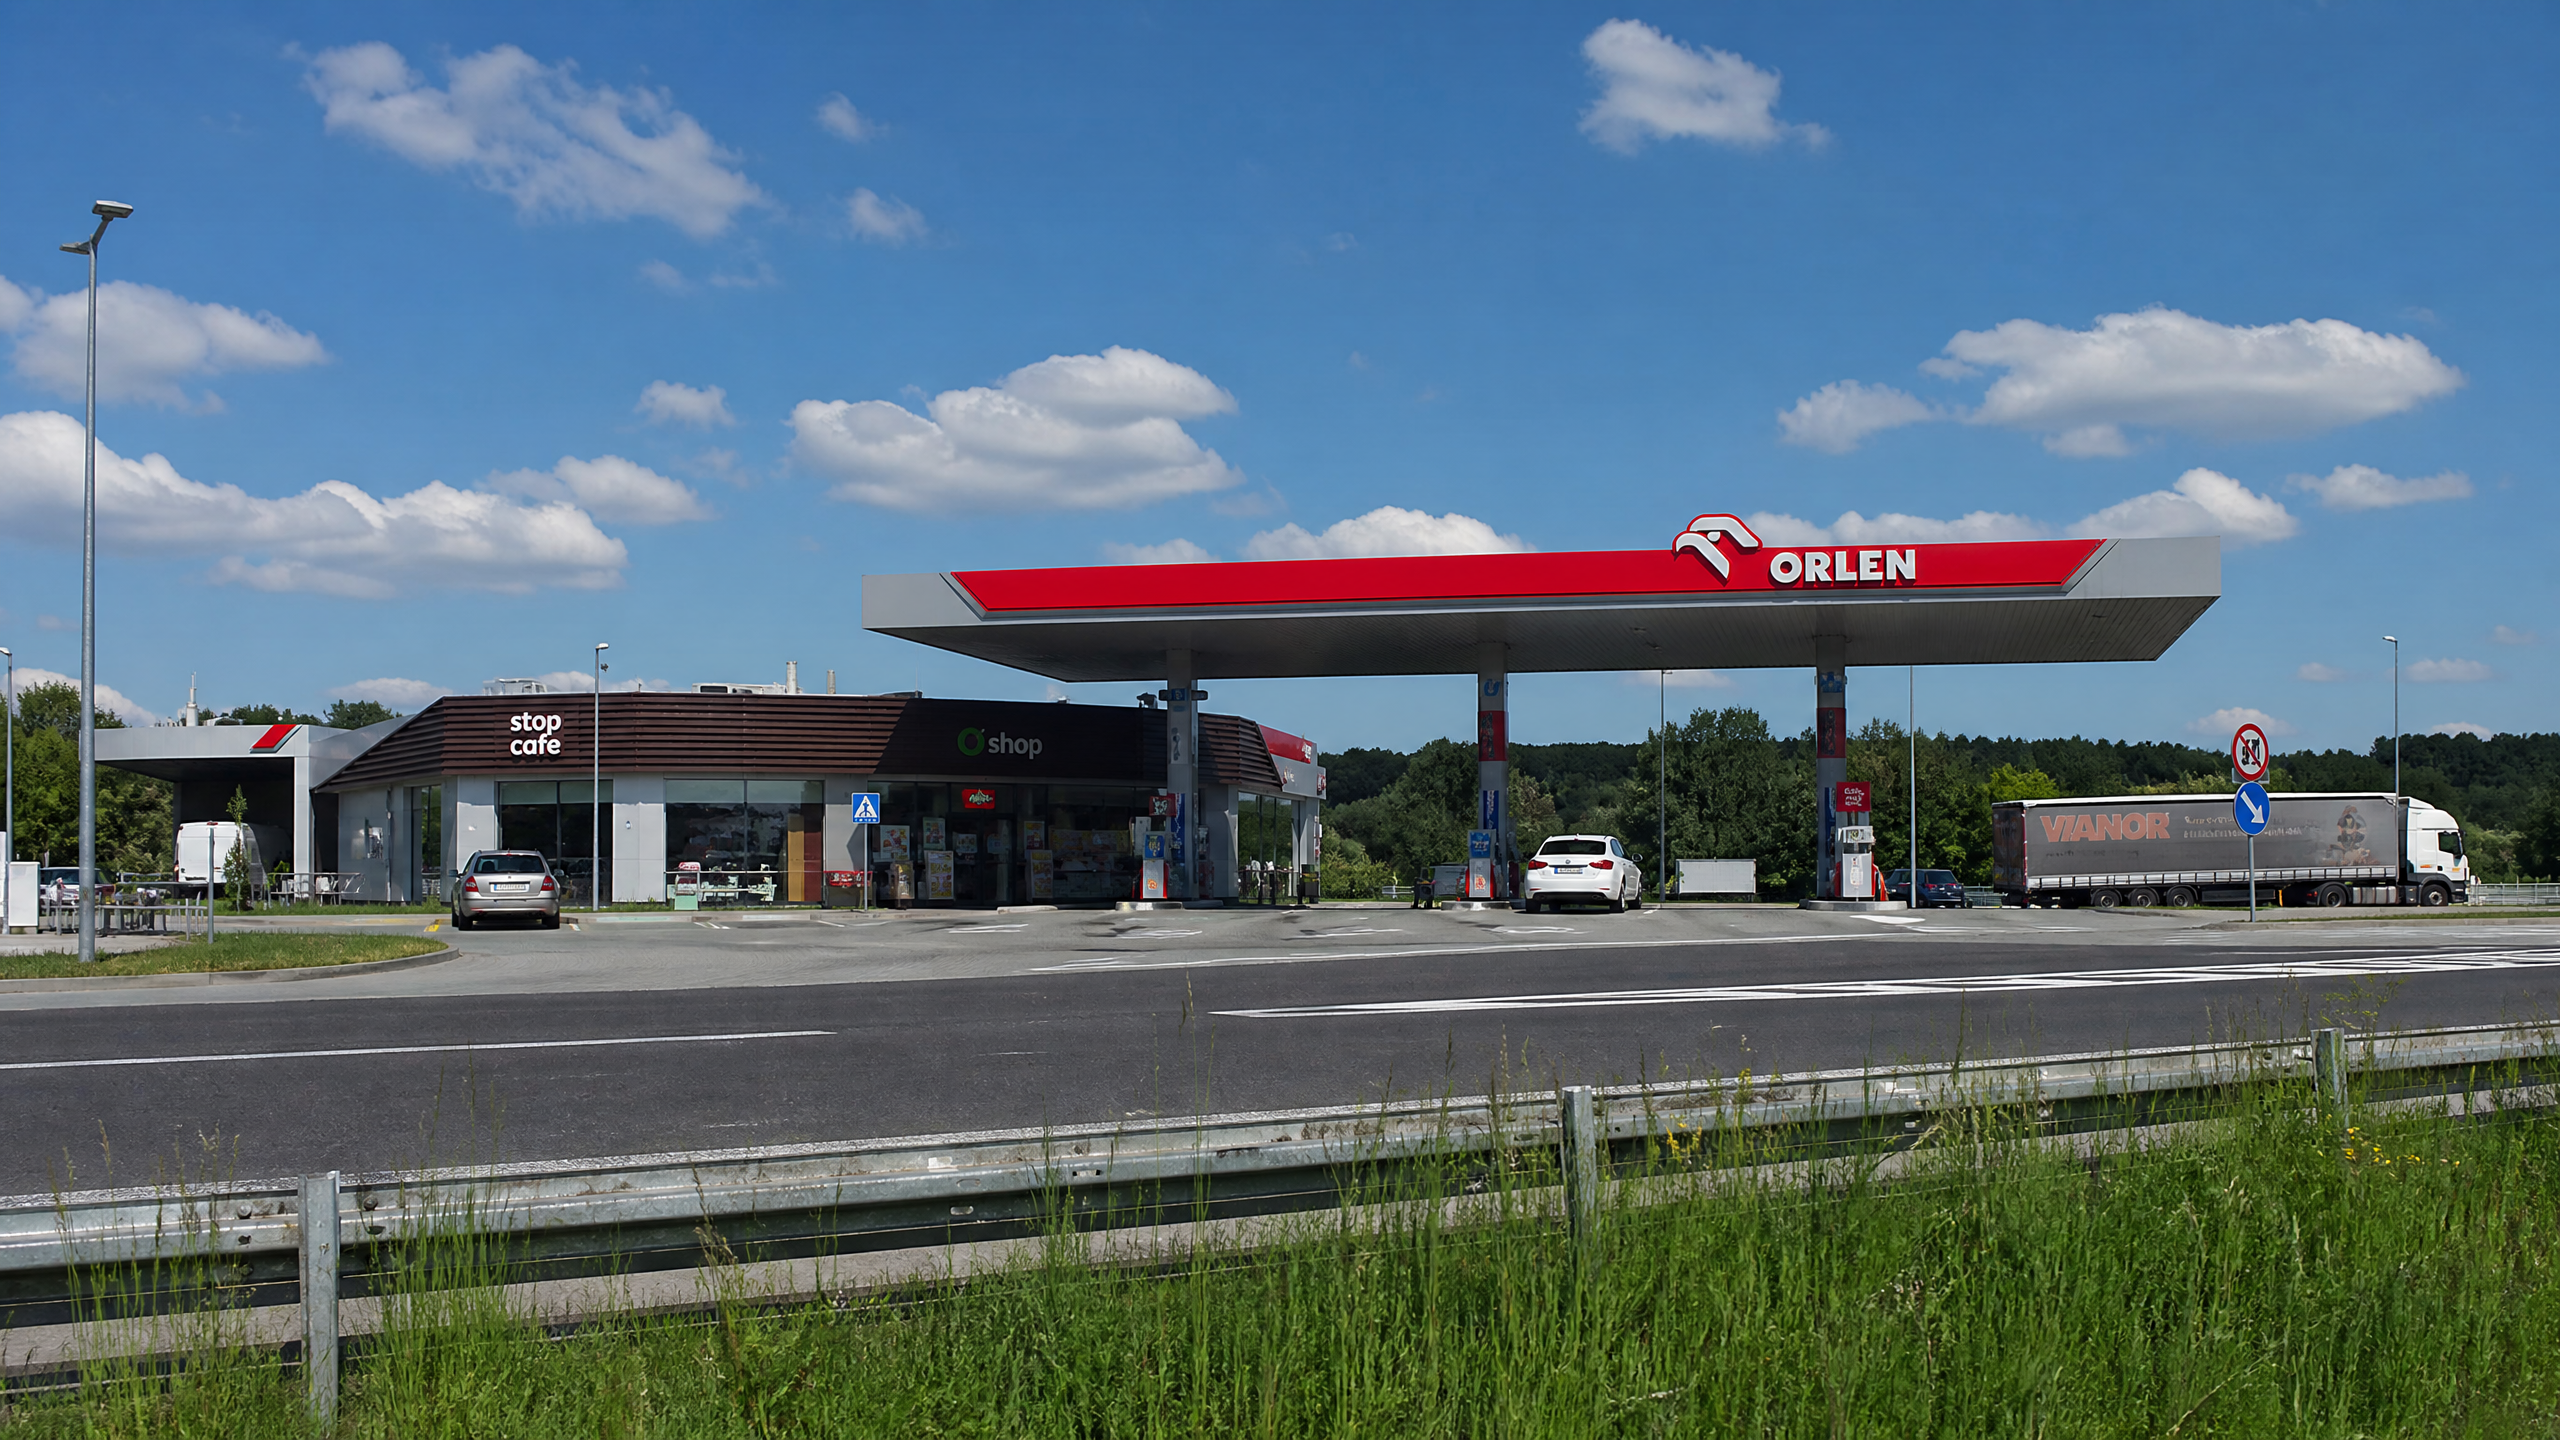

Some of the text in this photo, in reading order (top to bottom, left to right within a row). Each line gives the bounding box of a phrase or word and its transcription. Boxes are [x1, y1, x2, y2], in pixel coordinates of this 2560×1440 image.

[1769, 549, 1917, 584] ORLEN
[510, 712, 562, 736] stop
[510, 733, 561, 756] cafe
[988, 731, 1043, 760] shop
[2039, 812, 2171, 843] VIANOR
